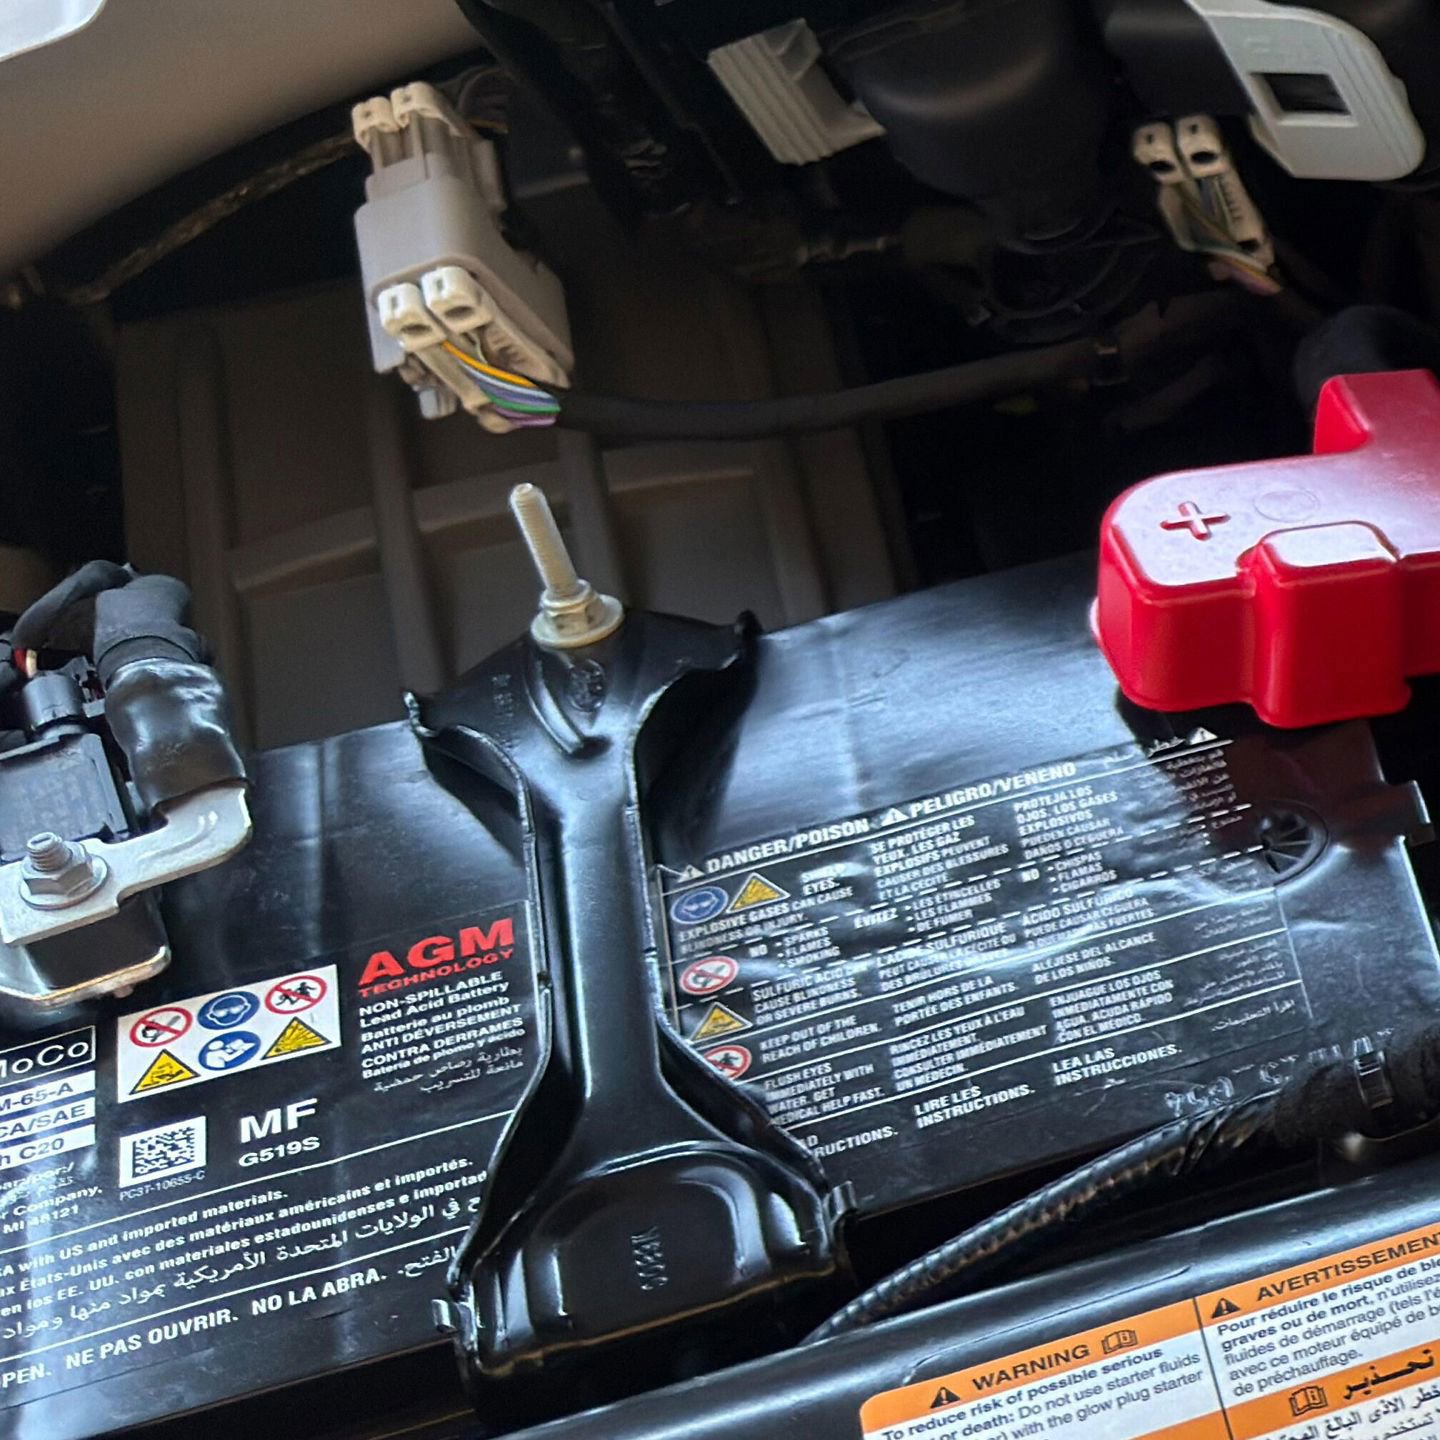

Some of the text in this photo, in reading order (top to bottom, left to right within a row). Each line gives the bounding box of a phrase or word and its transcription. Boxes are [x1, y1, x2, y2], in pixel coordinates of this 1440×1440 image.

[905, 761, 1081, 819] PELIGRO/VENENO
[706, 818, 874, 874] DANGER/POISON
[358, 918, 515, 986] AGM
[358, 948, 513, 998] TECHNOLOGY
[359, 970, 503, 1017] NON-SPILLABLE
[359, 981, 509, 1029] Lead Acid Battery
[360, 996, 510, 1043] Batterie au plomb
[361, 1003, 522, 1054] ANTI DÉVERSEMENT
[361, 1016, 524, 1069] CONTRA DERRAMES
[1051, 1047, 1115, 1074] LEA LAS
[1054, 1043, 1183, 1086] INSTRUCCIONES.
[239, 1097, 318, 1144] MF
[914, 1085, 982, 1116] LIRE LES
[916, 1084, 1036, 1129] INSTRUCTIONS.
[238, 1136, 321, 1167] G519S
[58, 1190, 289, 1260] US and imported materials.
[251, 1267, 387, 1316] NO LA ABRA.
[1217, 1317, 1256, 1336] Pour
[1260, 1298, 1319, 1322] réduire
[1322, 1292, 1338, 1303] le
[1341, 1274, 1393, 1297] risque
[1396, 1267, 1417, 1280] de
[61, 1308, 239, 1372] NE PAS OUVRIR.
[1221, 1326, 1278, 1353] graves
[1280, 1318, 1303, 1331] ou
[1306, 1310, 1327, 1323] de
[1330, 1295, 1374, 1316] mort,
[1223, 1342, 1276, 1366] fluides
[1278, 1334, 1299, 1348] de
[1302, 1307, 1386, 1340] démarrage
[1388, 1295, 1423, 1315] (tels
[1229, 1361, 1268, 1381] avec
[1269, 1354, 1290, 1368] ce
[1292, 1335, 1347, 1361] moteur
[1350, 1315, 1403, 1342] équipé
[1405, 1310, 1426, 1324] de
[908, 1411, 967, 1436] reduce
[970, 1398, 1003, 1417] risk
[1006, 1390, 1023, 1405] of
[1027, 1369, 1097, 1401] possible
[1100, 1348, 1163, 1375] serious
[971, 1344, 1090, 1391] WARNING
[1233, 1349, 1363, 1397] de préchauffage.
[961, 1413, 1015, 1437] death:
[1018, 1404, 1042, 1420] Do
[1045, 1393, 1072, 1411] not
[1074, 1385, 1103, 1402] use
[1106, 1367, 1156, 1391] starter
[1158, 1354, 1201, 1374] fluids
[1011, 1421, 1045, 1440] with
[1046, 1413, 1073, 1429] the
[1076, 1399, 1113, 1422] glow
[1116, 1388, 1151, 1409] plug
[1152, 1370, 1203, 1395] starter
